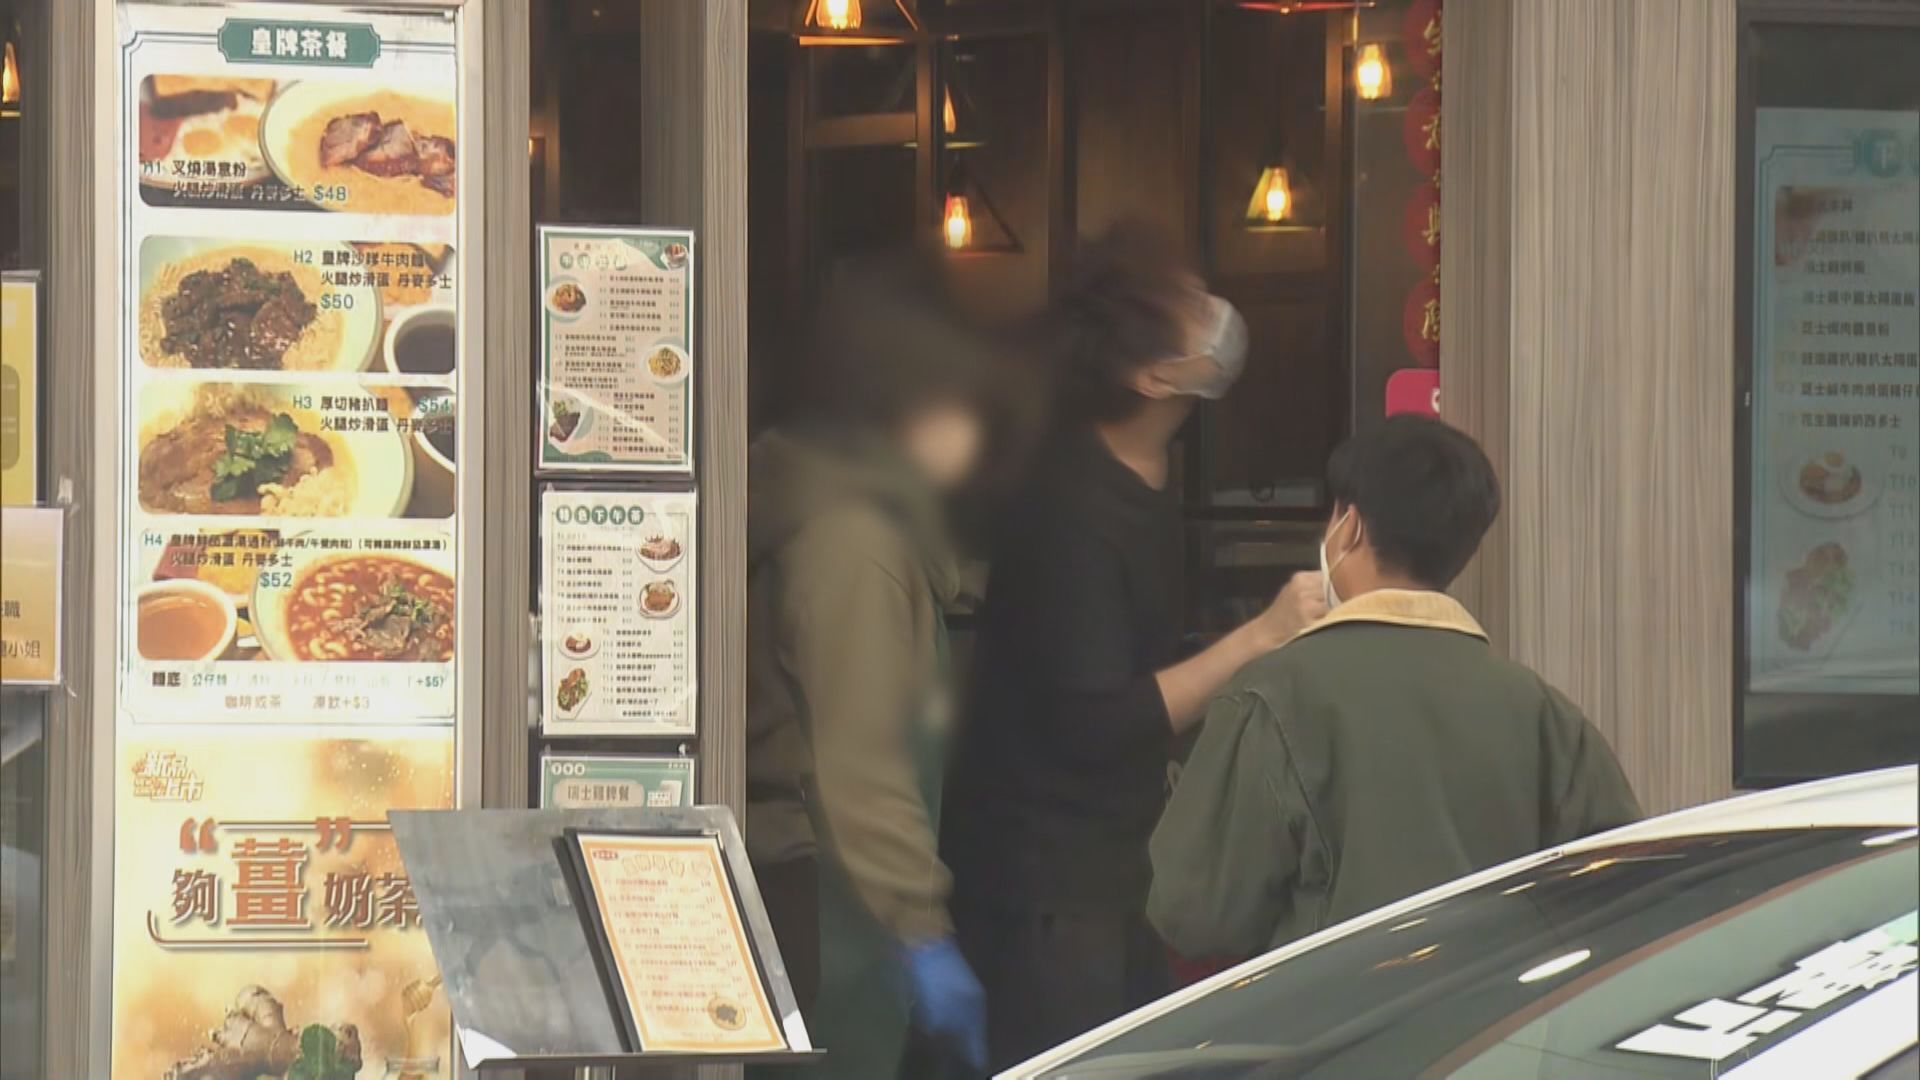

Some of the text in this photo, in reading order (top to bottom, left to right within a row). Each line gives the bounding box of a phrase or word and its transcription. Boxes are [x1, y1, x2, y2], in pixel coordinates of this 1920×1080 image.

[251, 27, 348, 60] 皇牌茶餐
[143, 160, 247, 177] H1 叉燒湯意粉
[313, 184, 347, 201] $48
[293, 249, 313, 264] H2
[321, 271, 452, 289] 火腿炒滑蛋 丹麥多士
[320, 293, 354, 310] $50
[292, 395, 451, 413] H3 厚切豬扒麵 $54
[320, 417, 389, 433] 火腿炒滑蛋
[144, 533, 163, 546] H4
[259, 572, 292, 588] $52
